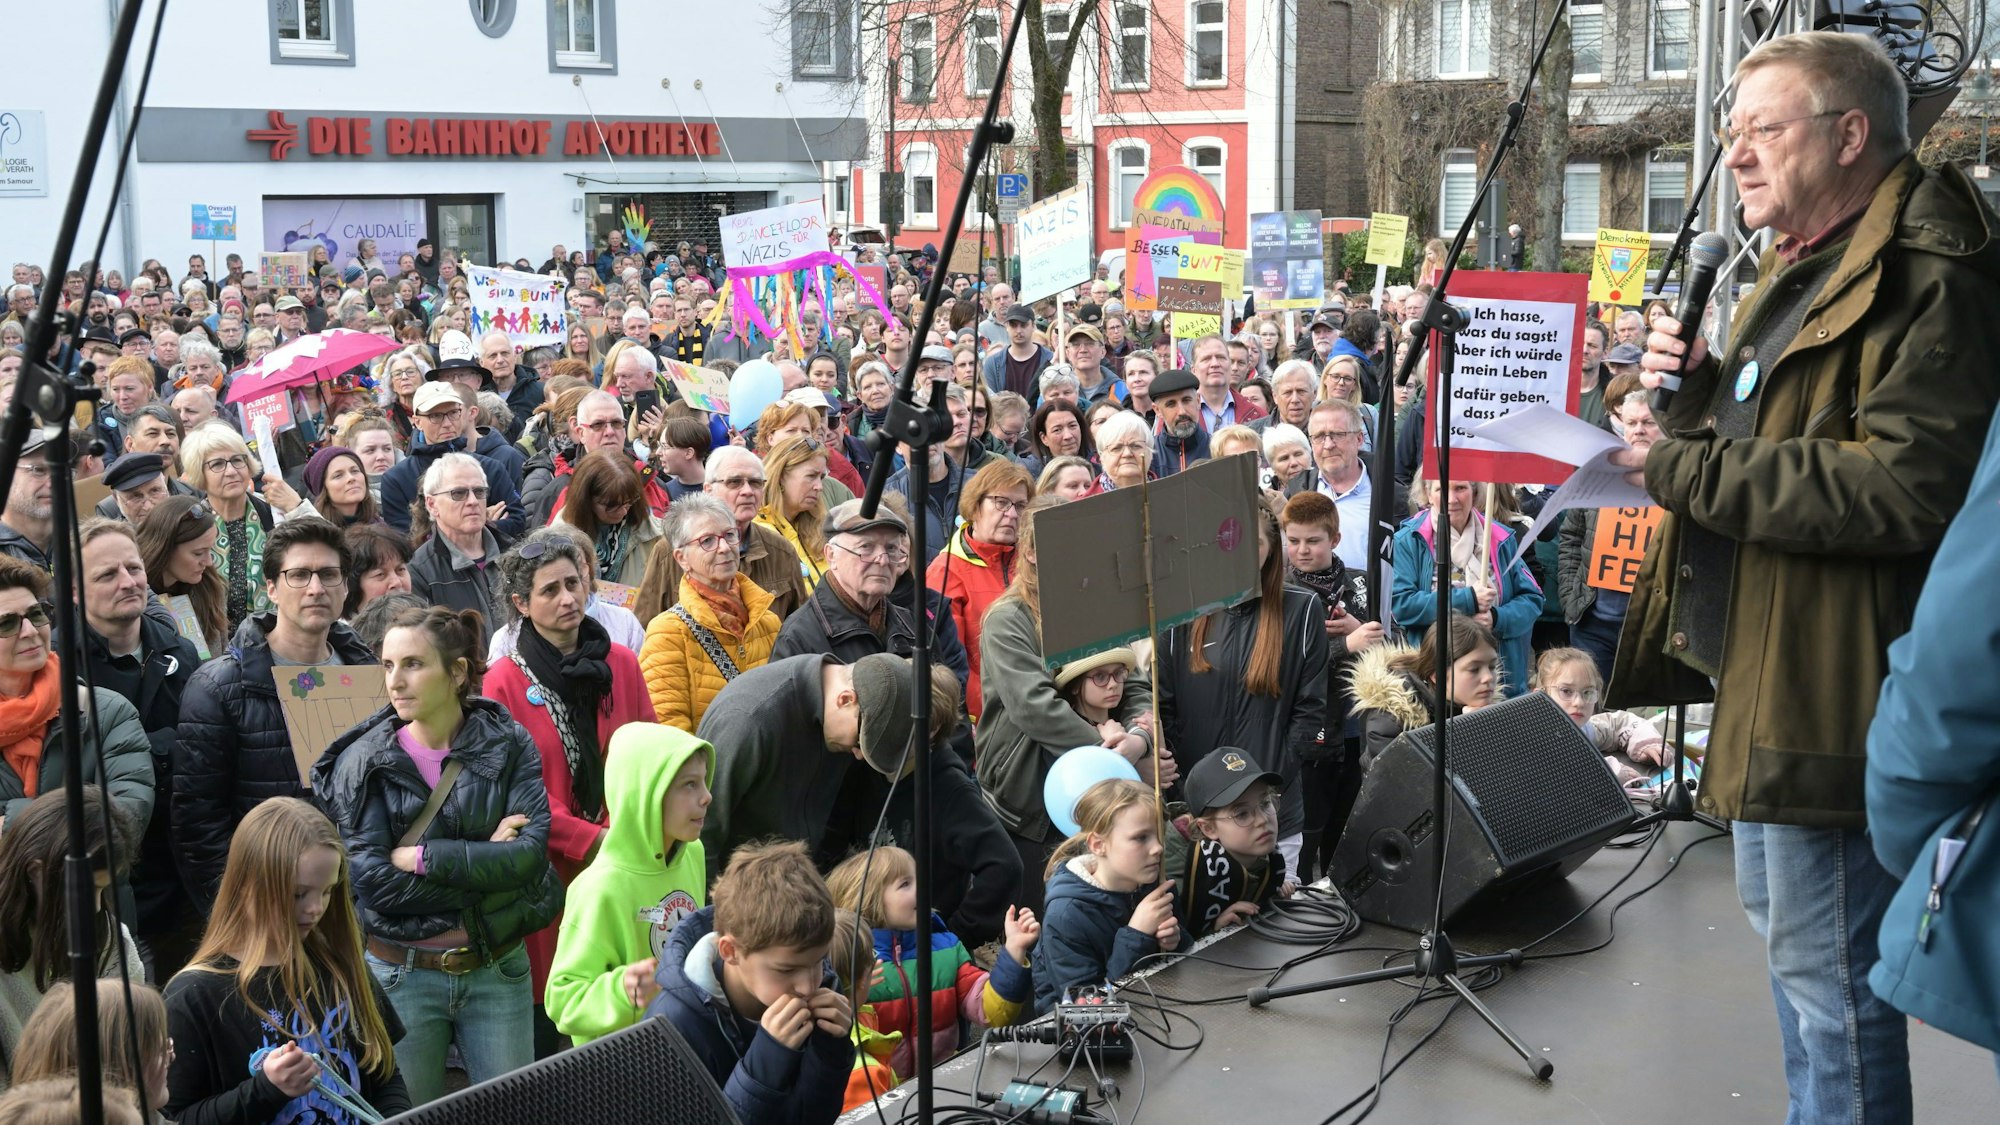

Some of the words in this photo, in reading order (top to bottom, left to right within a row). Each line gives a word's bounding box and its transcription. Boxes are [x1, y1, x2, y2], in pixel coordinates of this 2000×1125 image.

[307, 117, 372, 154] DIE
[386, 118, 552, 155] BAHNHOF
[563, 121, 720, 156] APOTHEKE
[1002, 177, 1015, 194] P
[1023, 199, 1079, 240] NAZIS
[736, 216, 822, 244] DANCEFLOOR
[1600, 231, 1650, 245] Demokraten
[741, 241, 792, 266] NAZIS
[1131, 240, 1180, 257] BESSER
[1180, 255, 1224, 272] BUNT
[1618, 256, 1648, 291] Mitmachen
[488, 287, 515, 299] SIND
[520, 288, 560, 303] BUNT
[1179, 282, 1206, 296] ALS
[1474, 307, 1496, 321] Ich
[1500, 308, 1545, 325] hasse,
[1178, 317, 1207, 334] NAZIS
[1458, 327, 1486, 338] was
[1491, 327, 1511, 340] du
[1515, 330, 1558, 344] sagst!
[459, 340, 470, 355] 33
[1453, 343, 1486, 357] Aber
[1490, 346, 1511, 359] ich
[1515, 348, 1563, 362] würde
[1460, 364, 1498, 377] mein
[1502, 365, 1548, 380] Leben
[1453, 387, 1496, 401] dafür
[1499, 390, 1550, 404] geben,
[265, 402, 282, 415] die
[1463, 406, 1495, 420] dass
